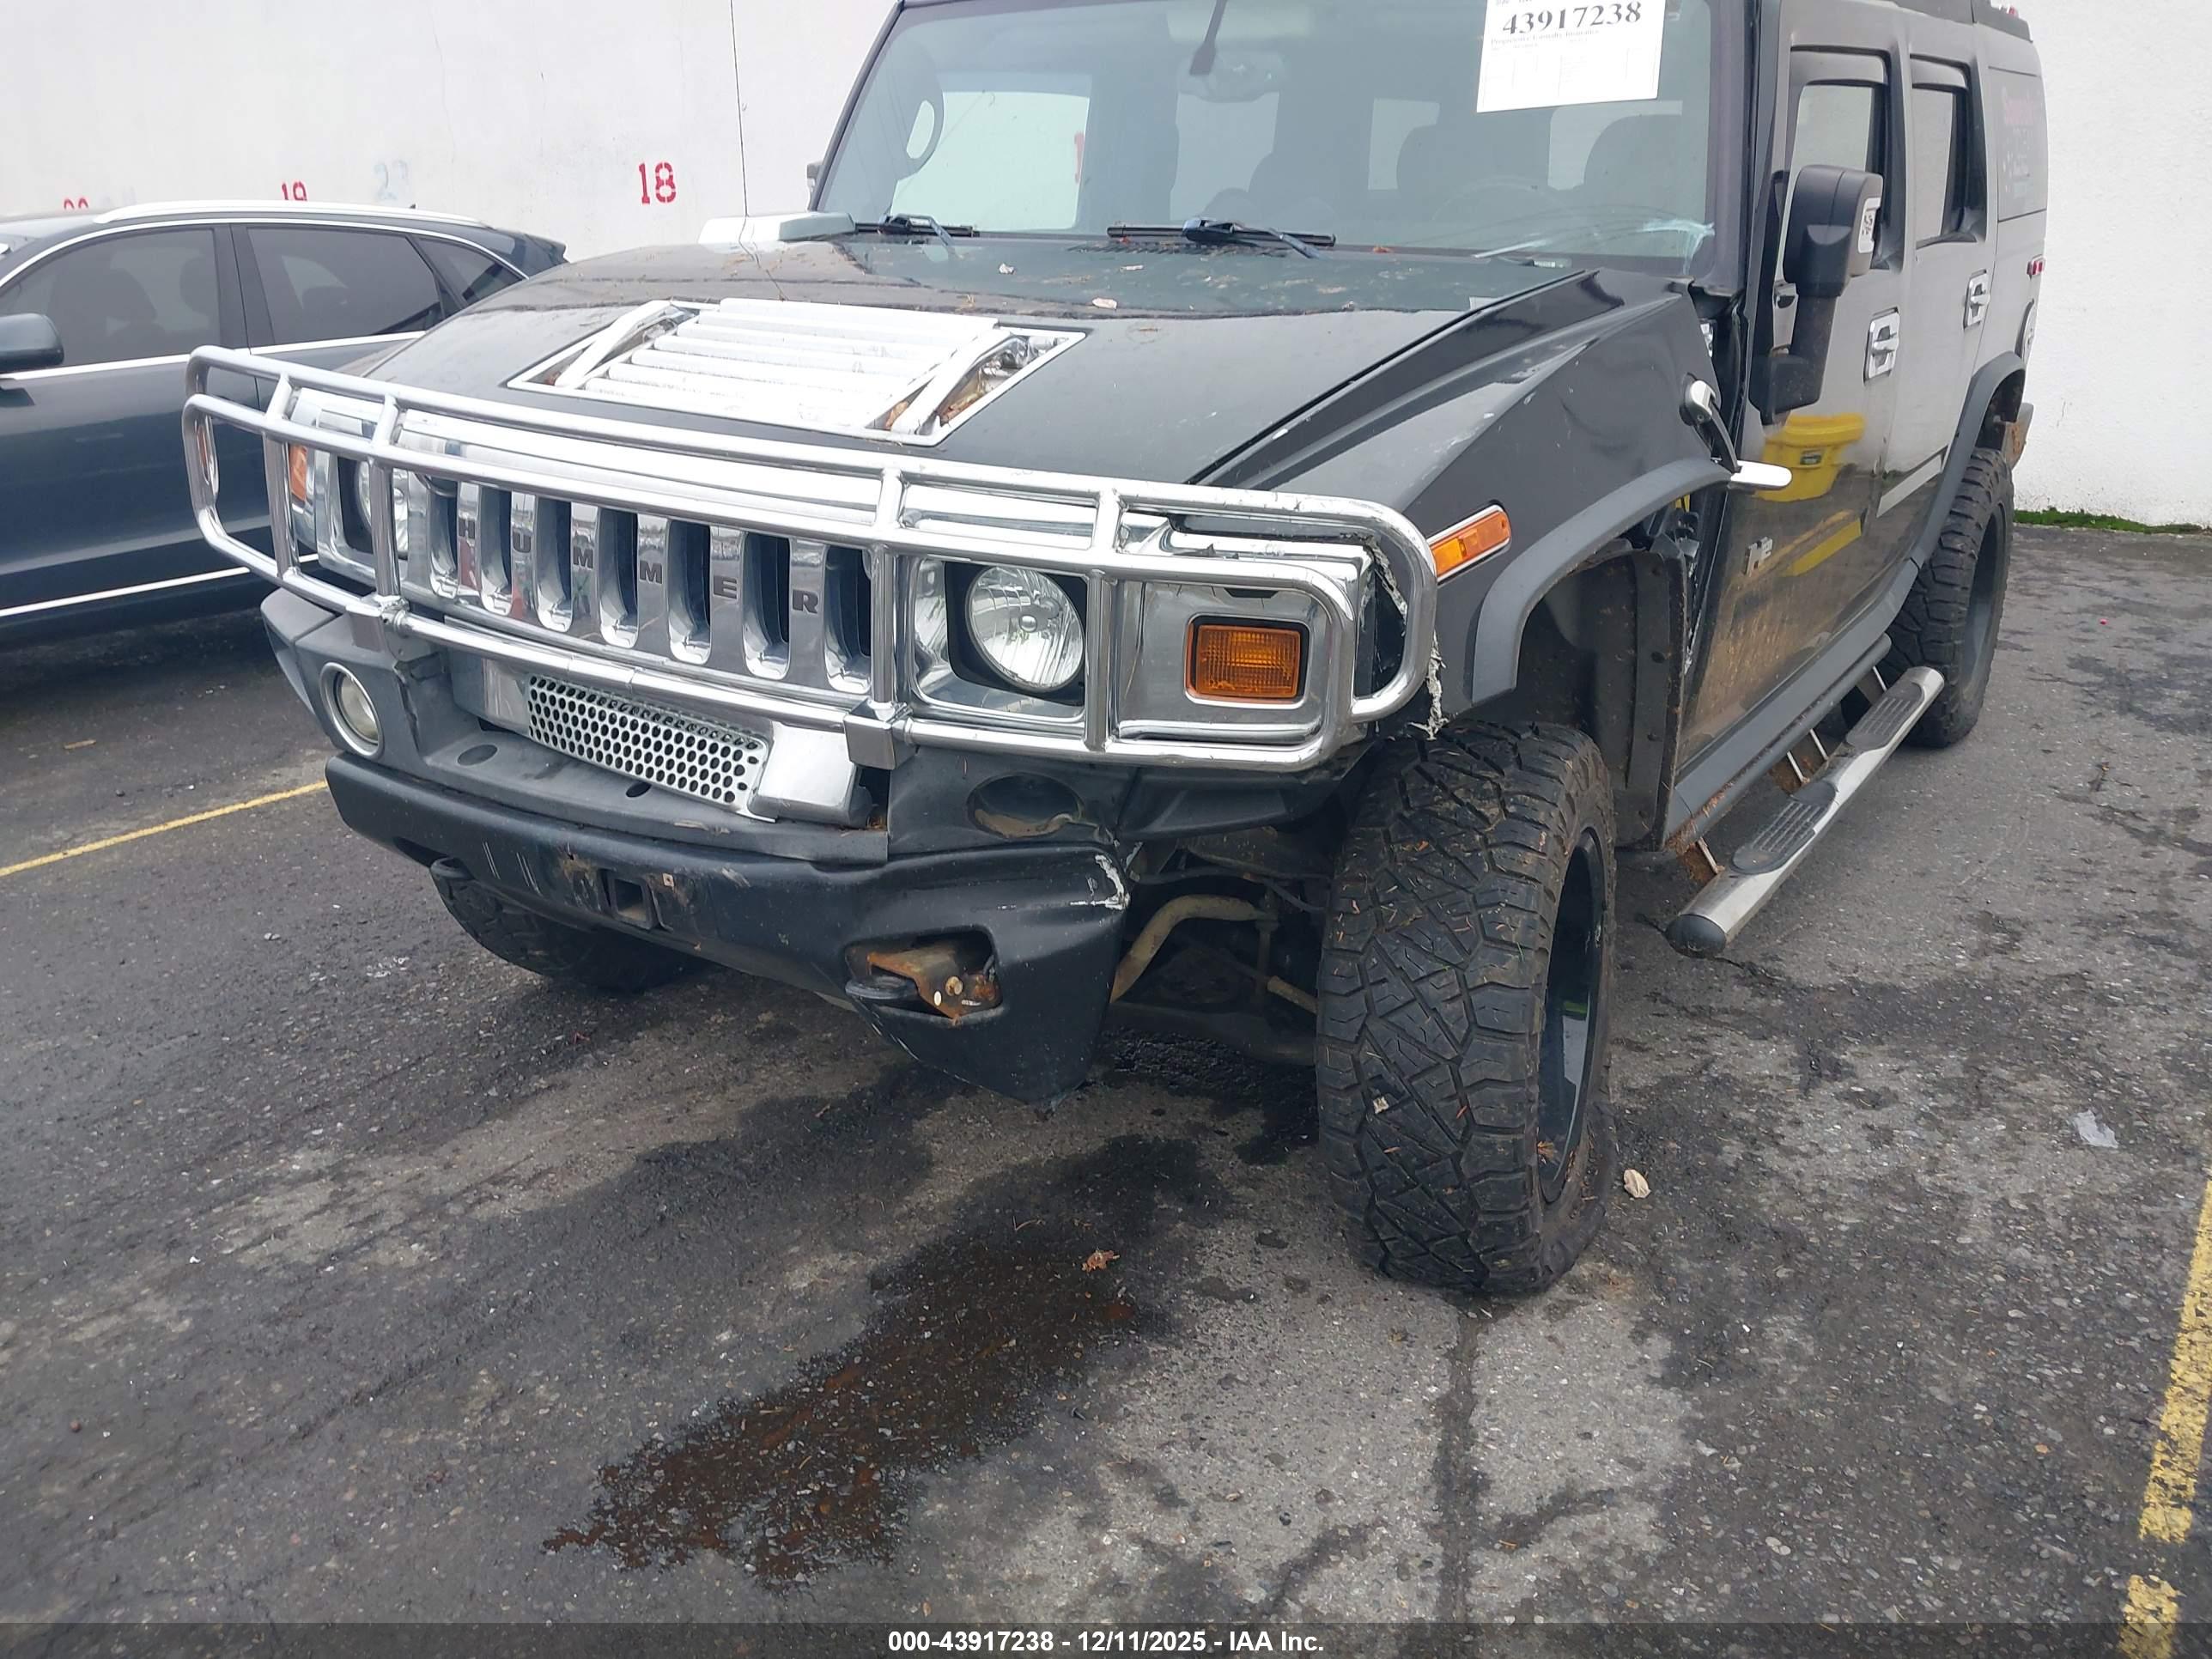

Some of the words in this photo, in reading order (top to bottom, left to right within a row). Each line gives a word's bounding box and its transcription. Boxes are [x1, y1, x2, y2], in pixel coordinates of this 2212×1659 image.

[1503, 2, 1641, 34] 43917238
[638, 162, 677, 204] 18
[458, 518, 819, 614] HUMMER
